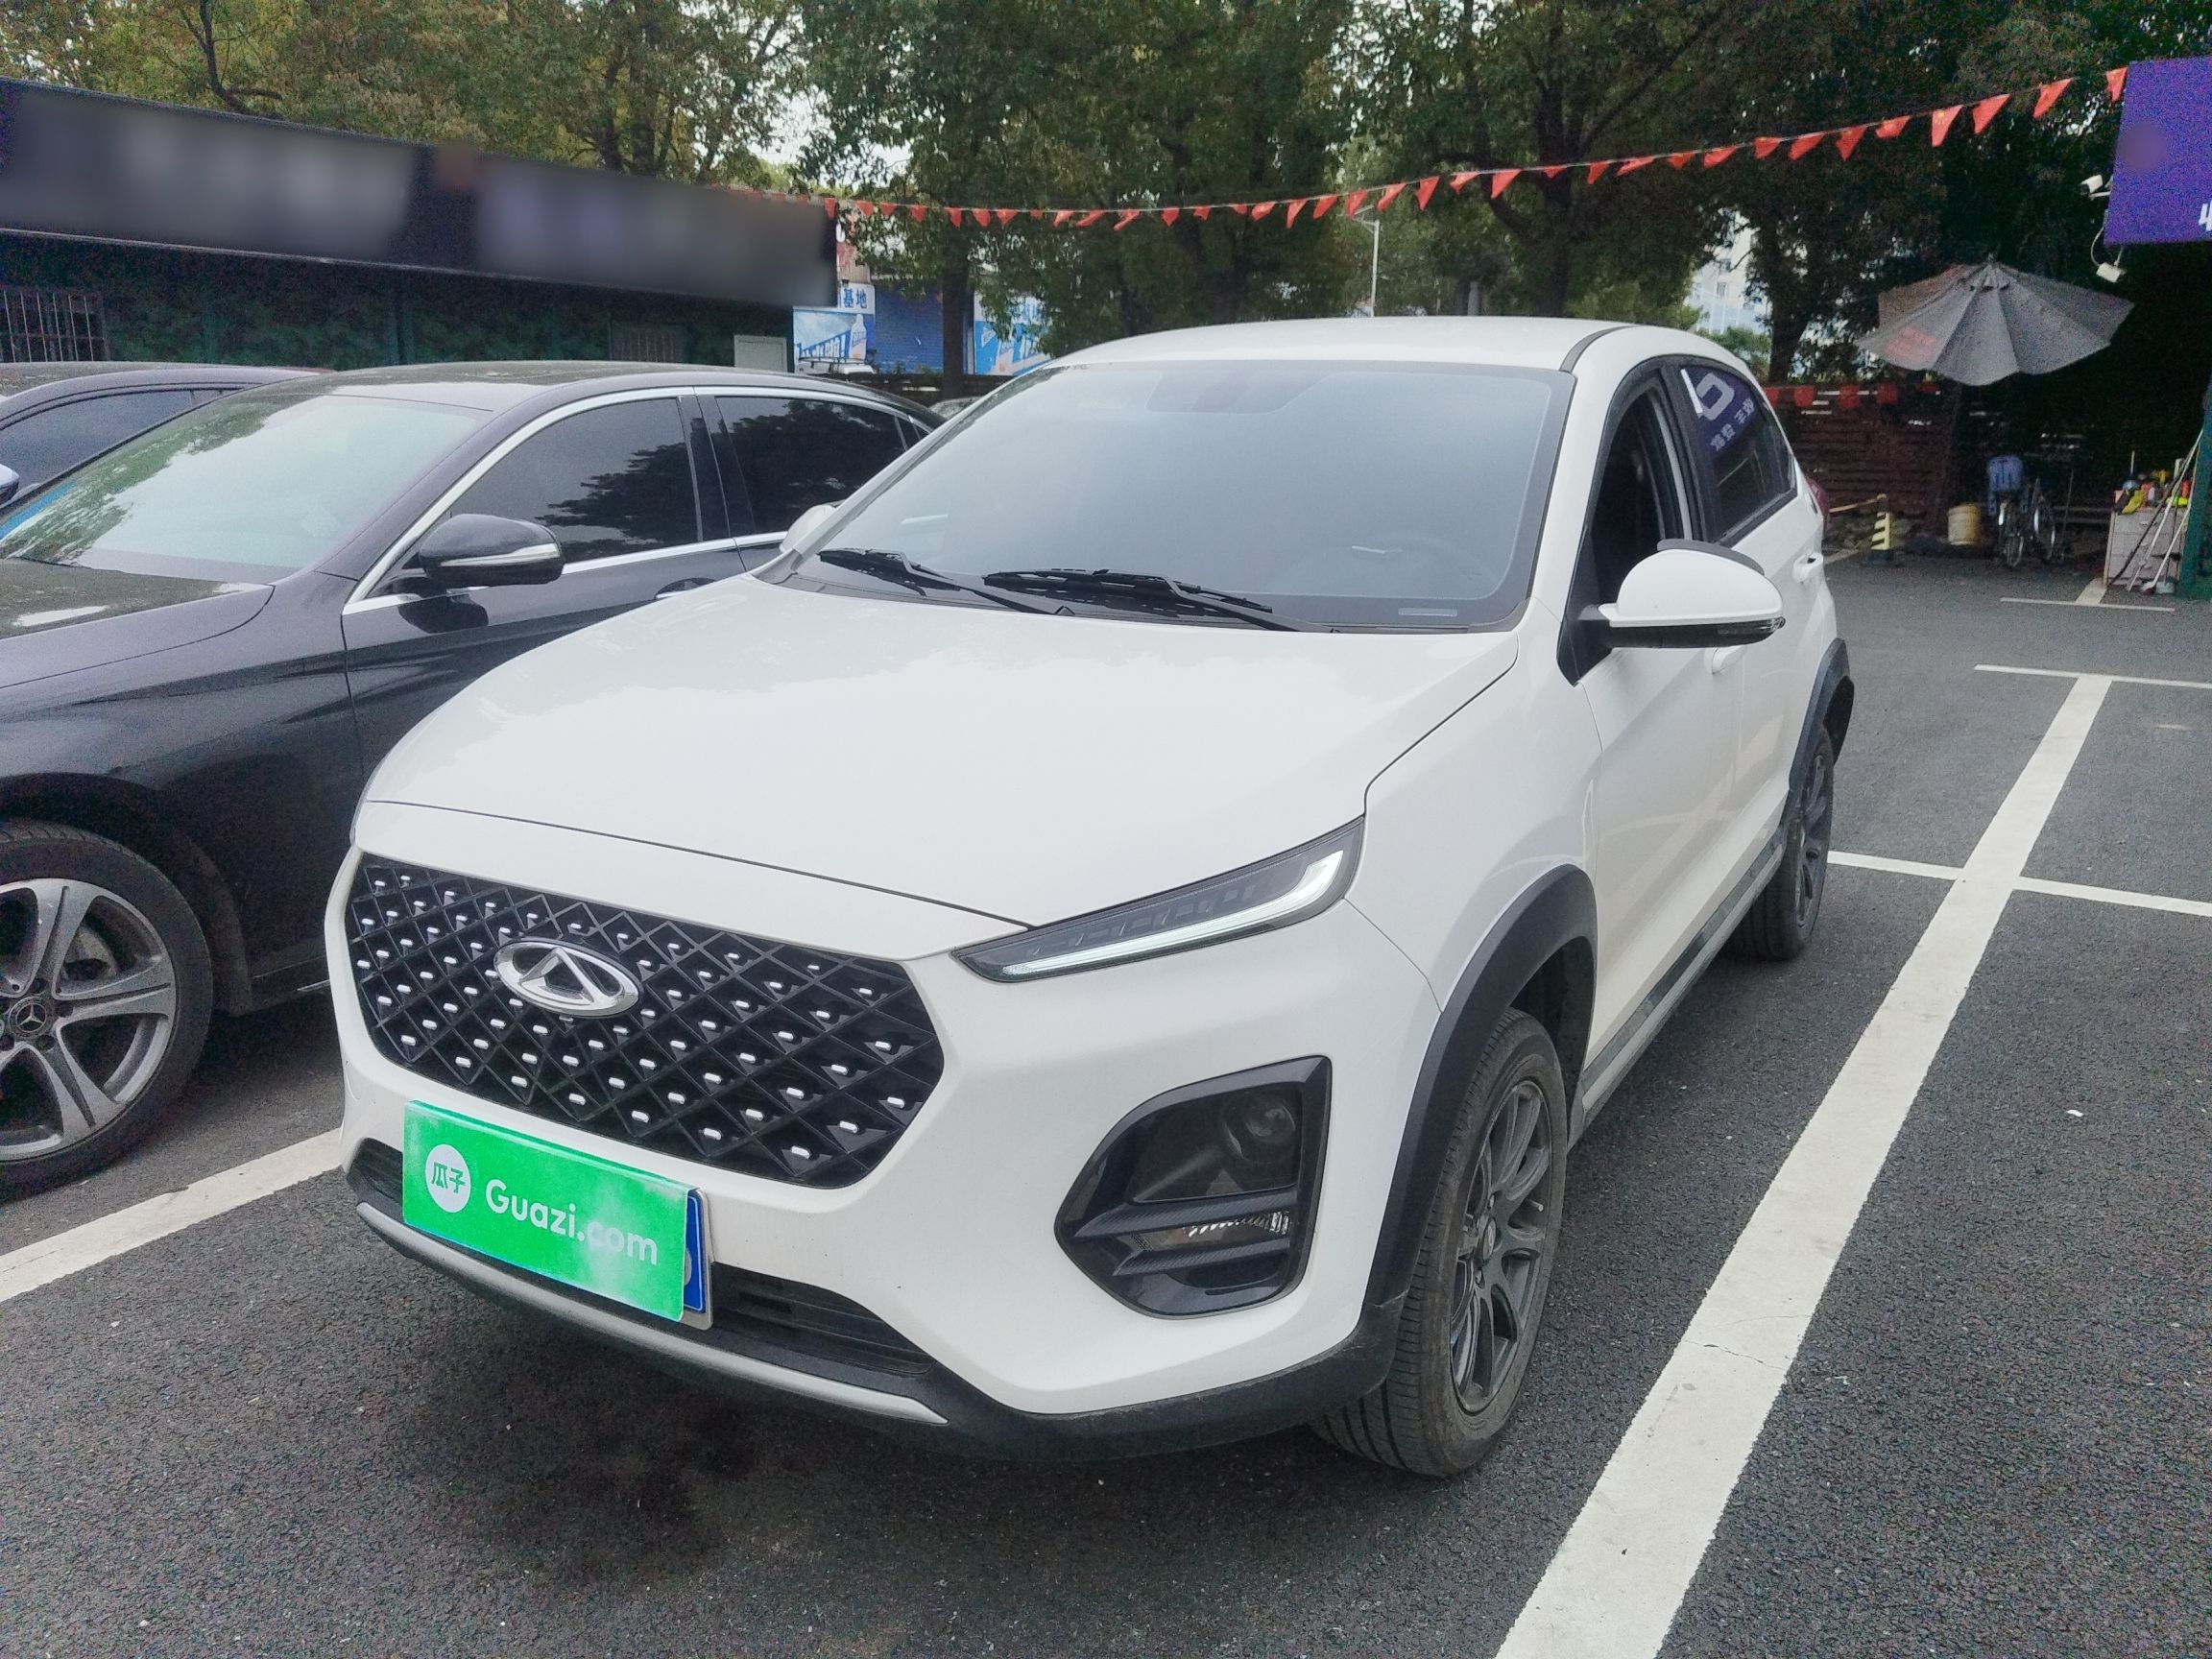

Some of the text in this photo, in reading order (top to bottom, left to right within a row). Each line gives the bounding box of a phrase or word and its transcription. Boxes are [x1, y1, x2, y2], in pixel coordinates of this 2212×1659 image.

[839, 287, 868, 309] 基地
[431, 1161, 467, 1194] 瓜子
[485, 1178, 659, 1265] Guazi.com
